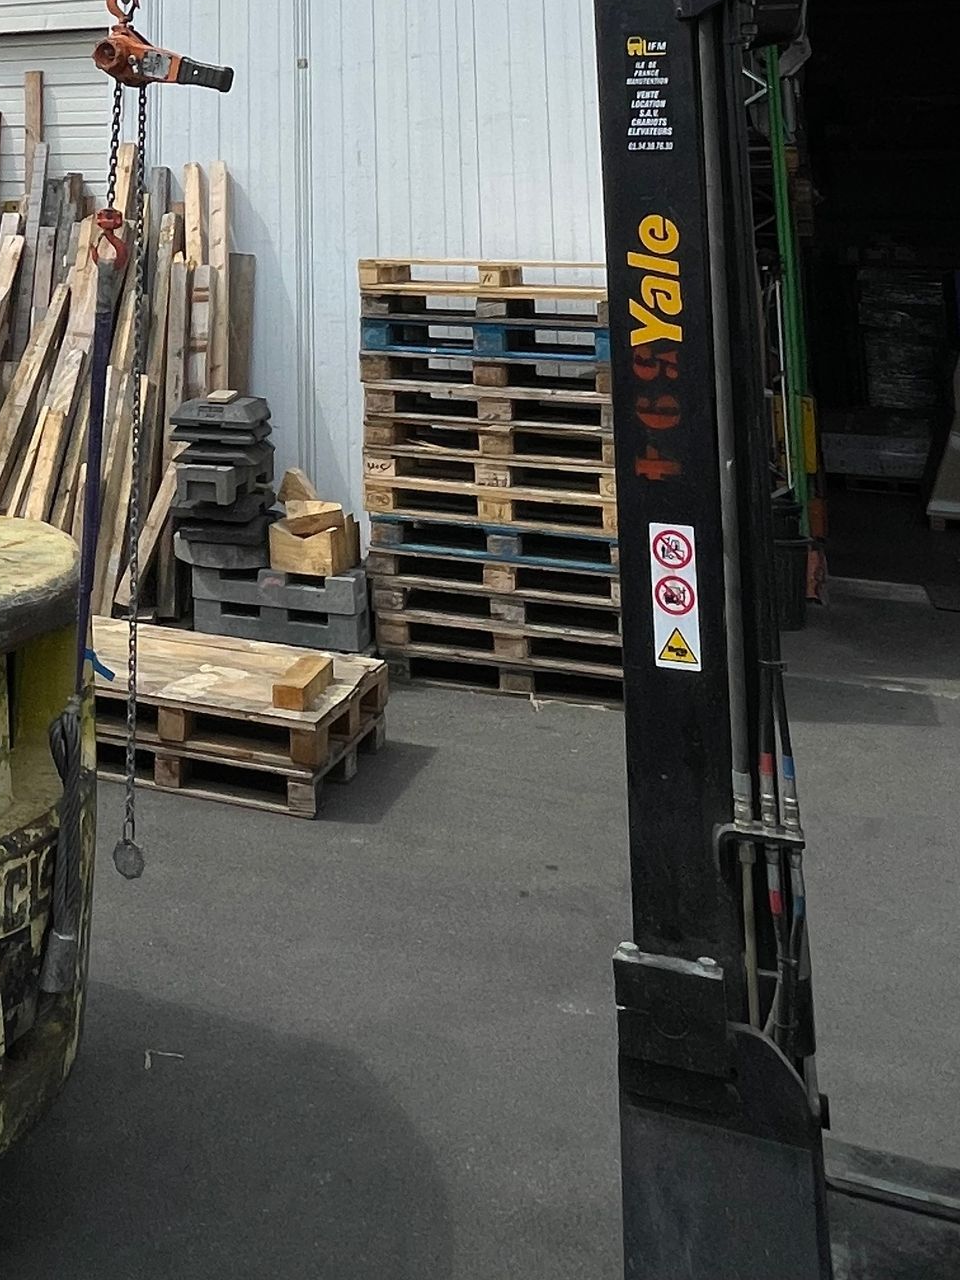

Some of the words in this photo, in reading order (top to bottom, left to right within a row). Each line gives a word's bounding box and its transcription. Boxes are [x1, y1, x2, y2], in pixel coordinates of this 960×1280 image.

[647, 41, 667, 52] IFM
[635, 61, 646, 69] ILE
[648, 61, 657, 69] DE
[633, 69, 660, 77] FRANCE
[626, 77, 669, 86] MANUTENTION
[636, 90, 660, 99] VENTE
[631, 99, 667, 109] LOCATION
[638, 109, 660, 118] S.A.V.
[631, 117, 668, 127] CHARIOTS
[627, 126, 673, 136] ELEVATEURS
[627, 213, 684, 347] Yale
